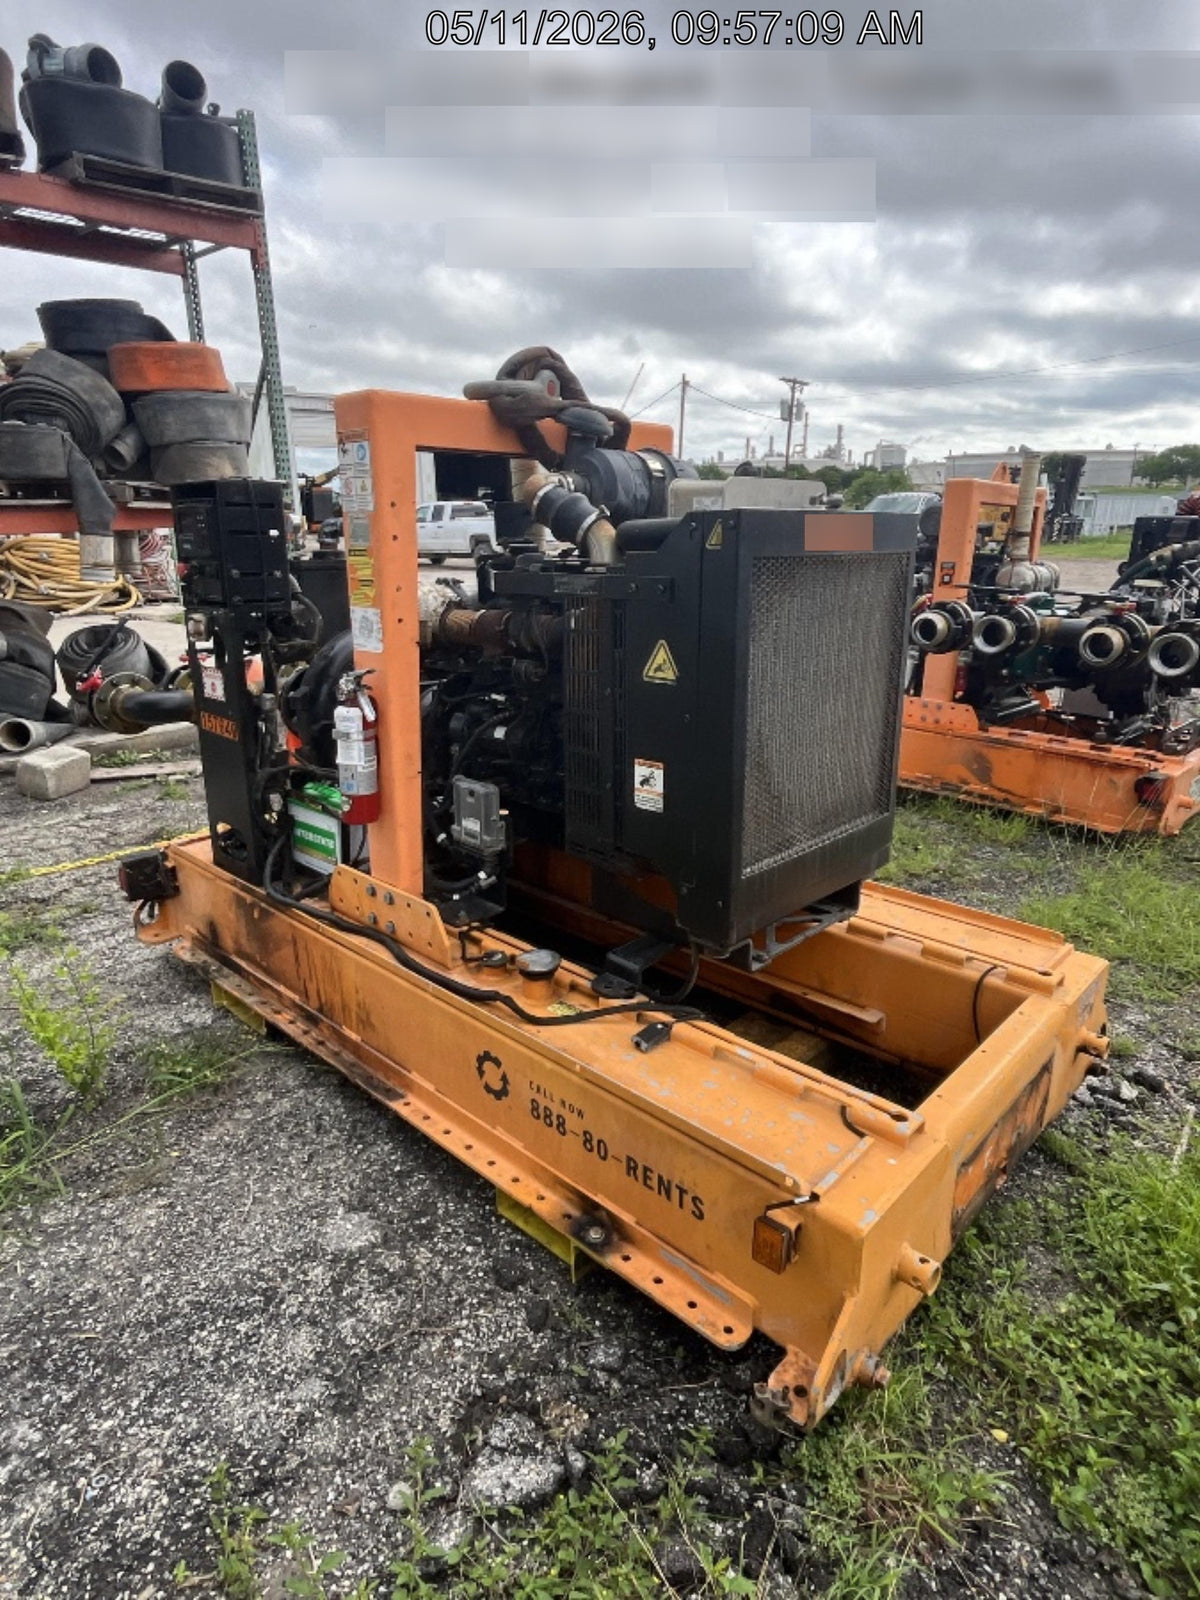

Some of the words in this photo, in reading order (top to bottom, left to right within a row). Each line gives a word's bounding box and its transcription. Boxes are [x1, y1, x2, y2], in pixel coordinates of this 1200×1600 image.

[529, 1080, 555, 1103] CALL
[560, 1098, 585, 1120] NOW
[530, 1098, 706, 1221] 888-80-RENTS
